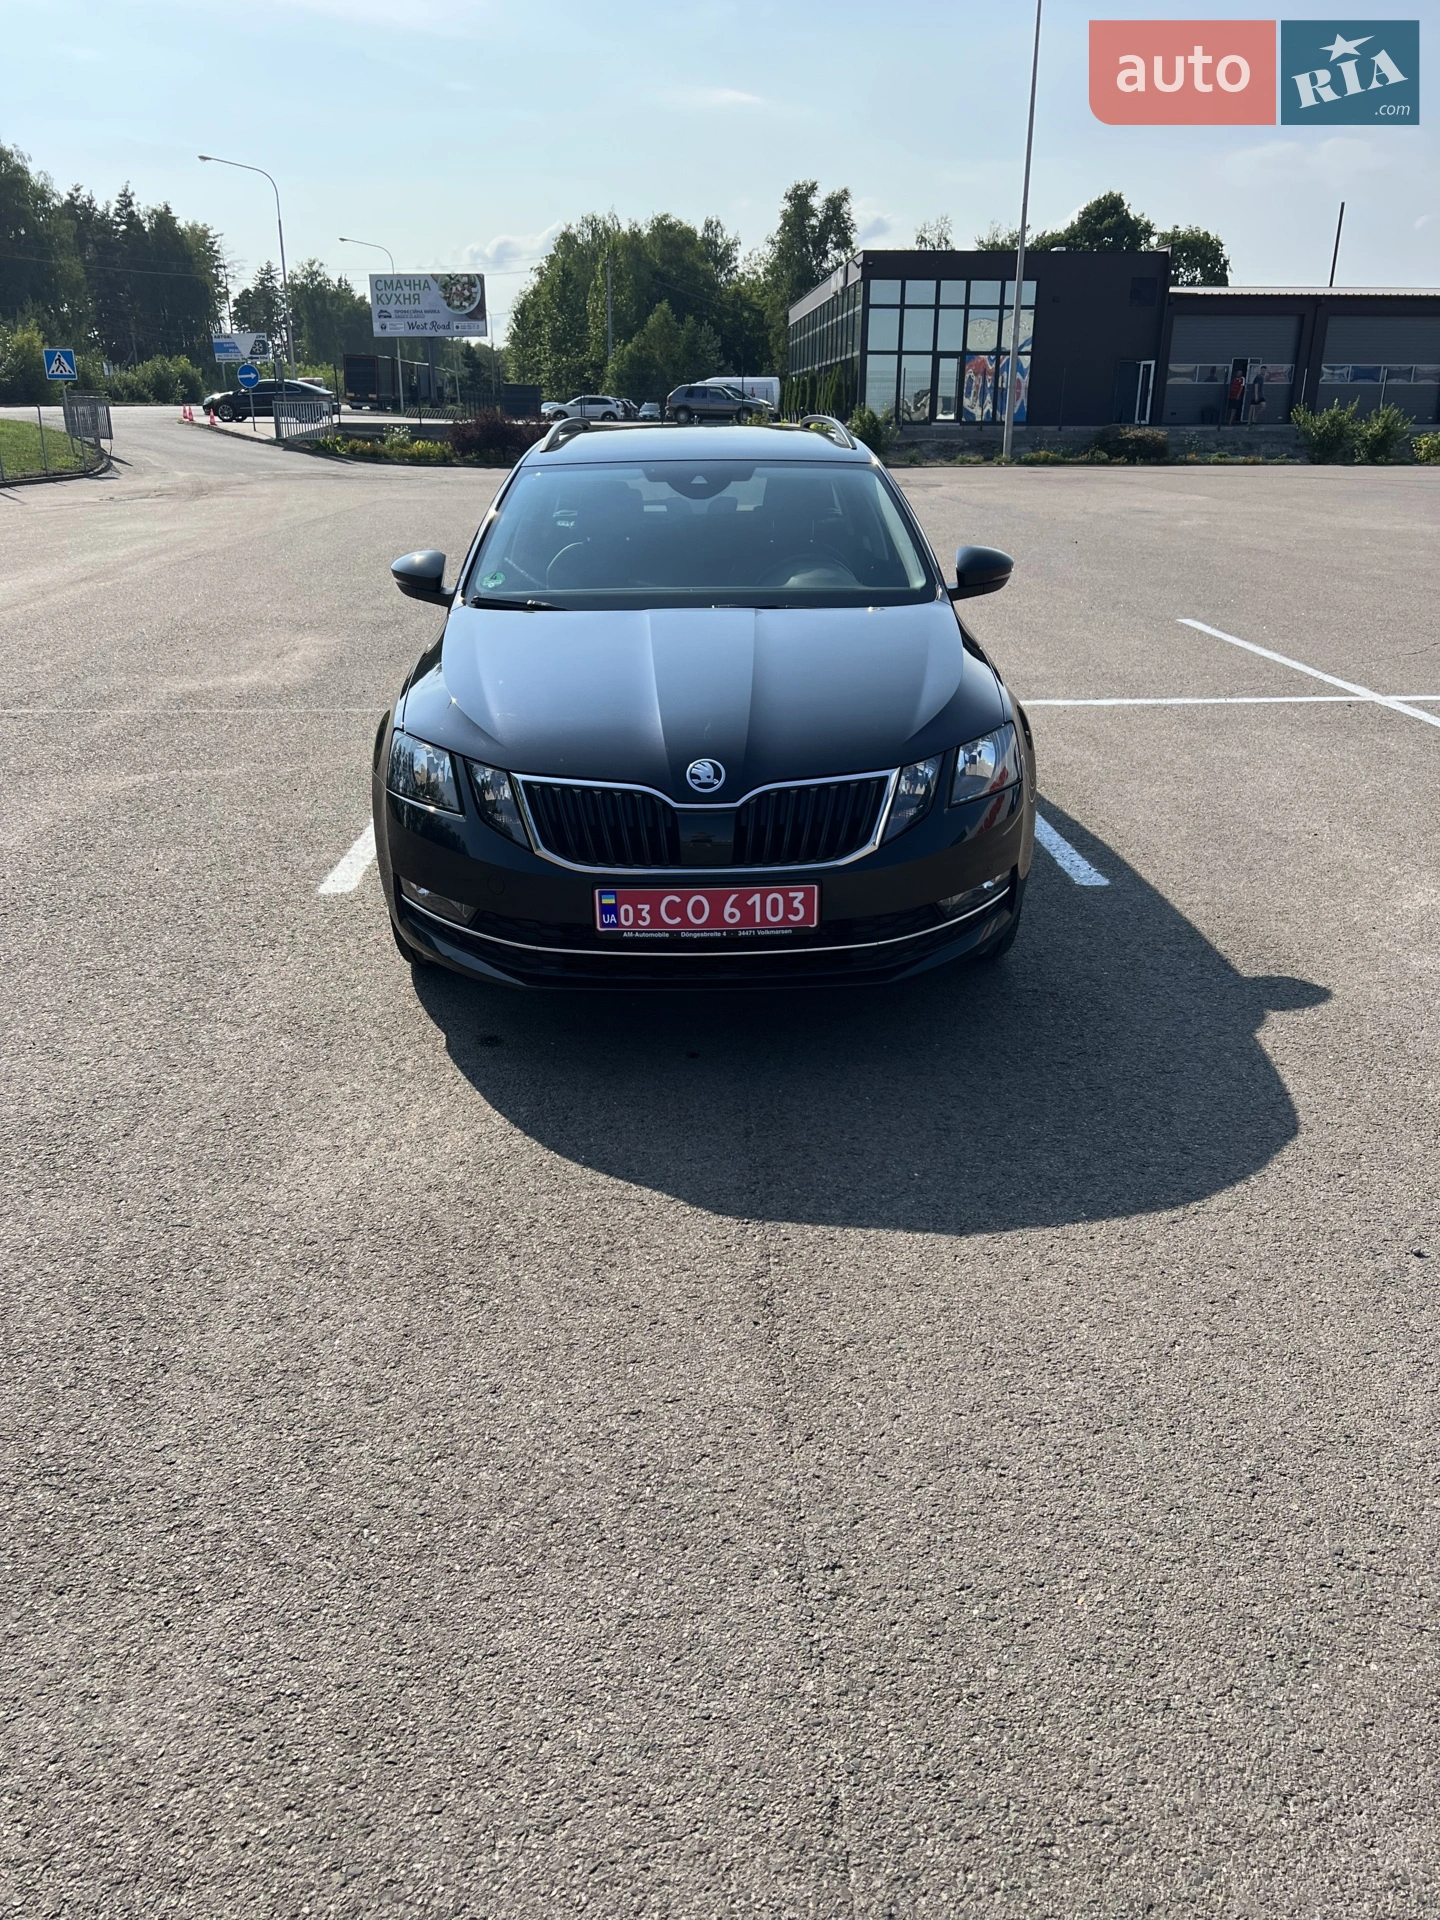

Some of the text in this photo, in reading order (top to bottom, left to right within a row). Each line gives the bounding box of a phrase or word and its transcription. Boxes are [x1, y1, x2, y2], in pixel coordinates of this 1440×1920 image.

[375, 279, 431, 292] СМАЧНА
[376, 293, 421, 306] КУХНЯ
[407, 321, 428, 331] West
[429, 320, 451, 332] Road
[619, 891, 805, 927] 03 CO 6103
[602, 913, 617, 924] UA
